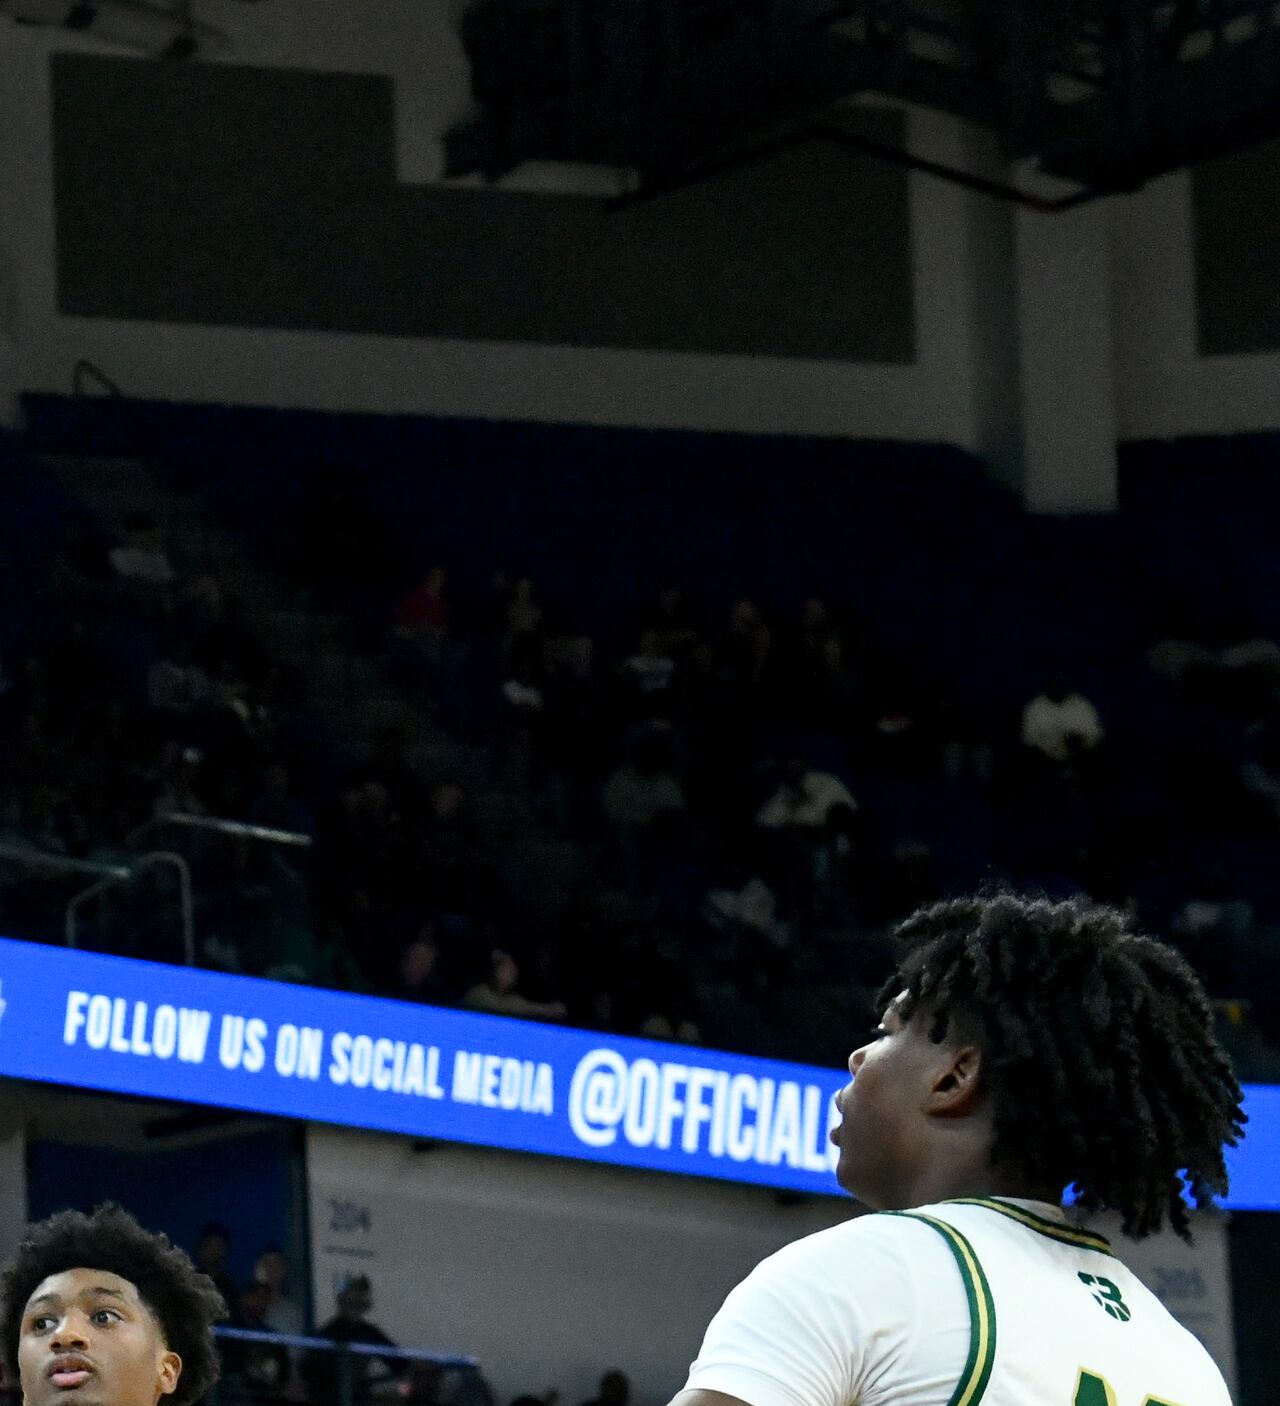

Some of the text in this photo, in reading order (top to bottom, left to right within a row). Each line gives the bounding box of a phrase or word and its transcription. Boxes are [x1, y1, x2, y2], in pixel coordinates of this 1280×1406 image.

[64, 991, 210, 1063] FOLLOW
[219, 1015, 267, 1072] US
[275, 1024, 323, 1079] ON
[329, 1032, 444, 1098] SOCIAL
[452, 1051, 553, 1114] MEDIA
